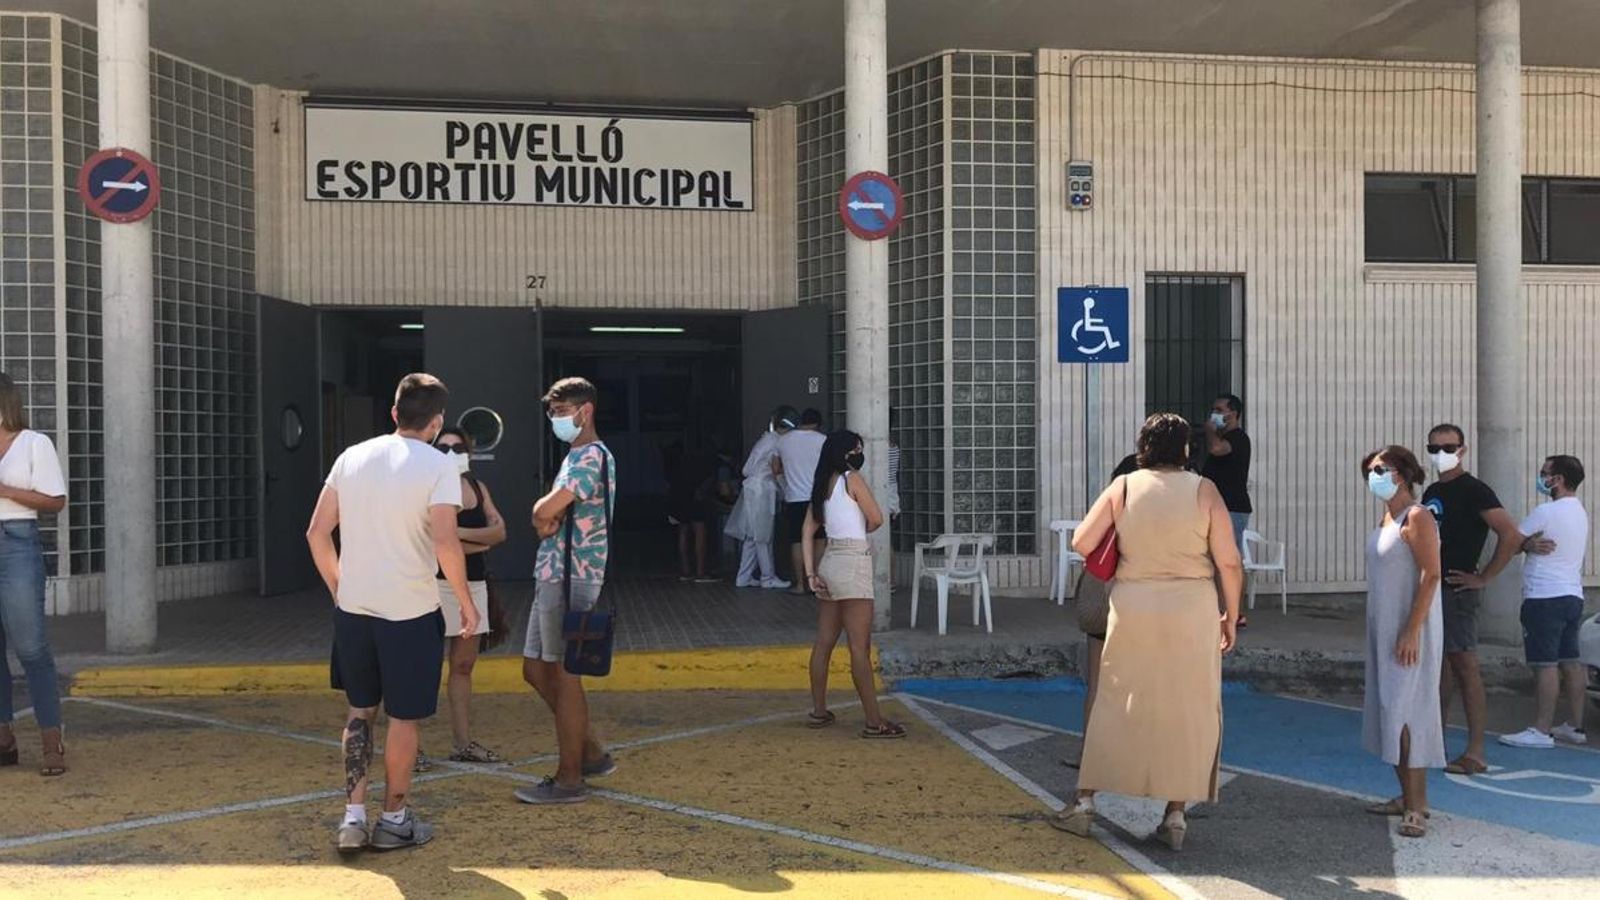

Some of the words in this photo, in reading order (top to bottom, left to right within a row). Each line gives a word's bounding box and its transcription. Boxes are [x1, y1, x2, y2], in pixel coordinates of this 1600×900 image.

[446, 119, 623, 163] PAVELLÓ
[316, 160, 515, 202] ESPORTIU
[535, 165, 744, 208] MUNICIPAL
[526, 275, 547, 289] 27
